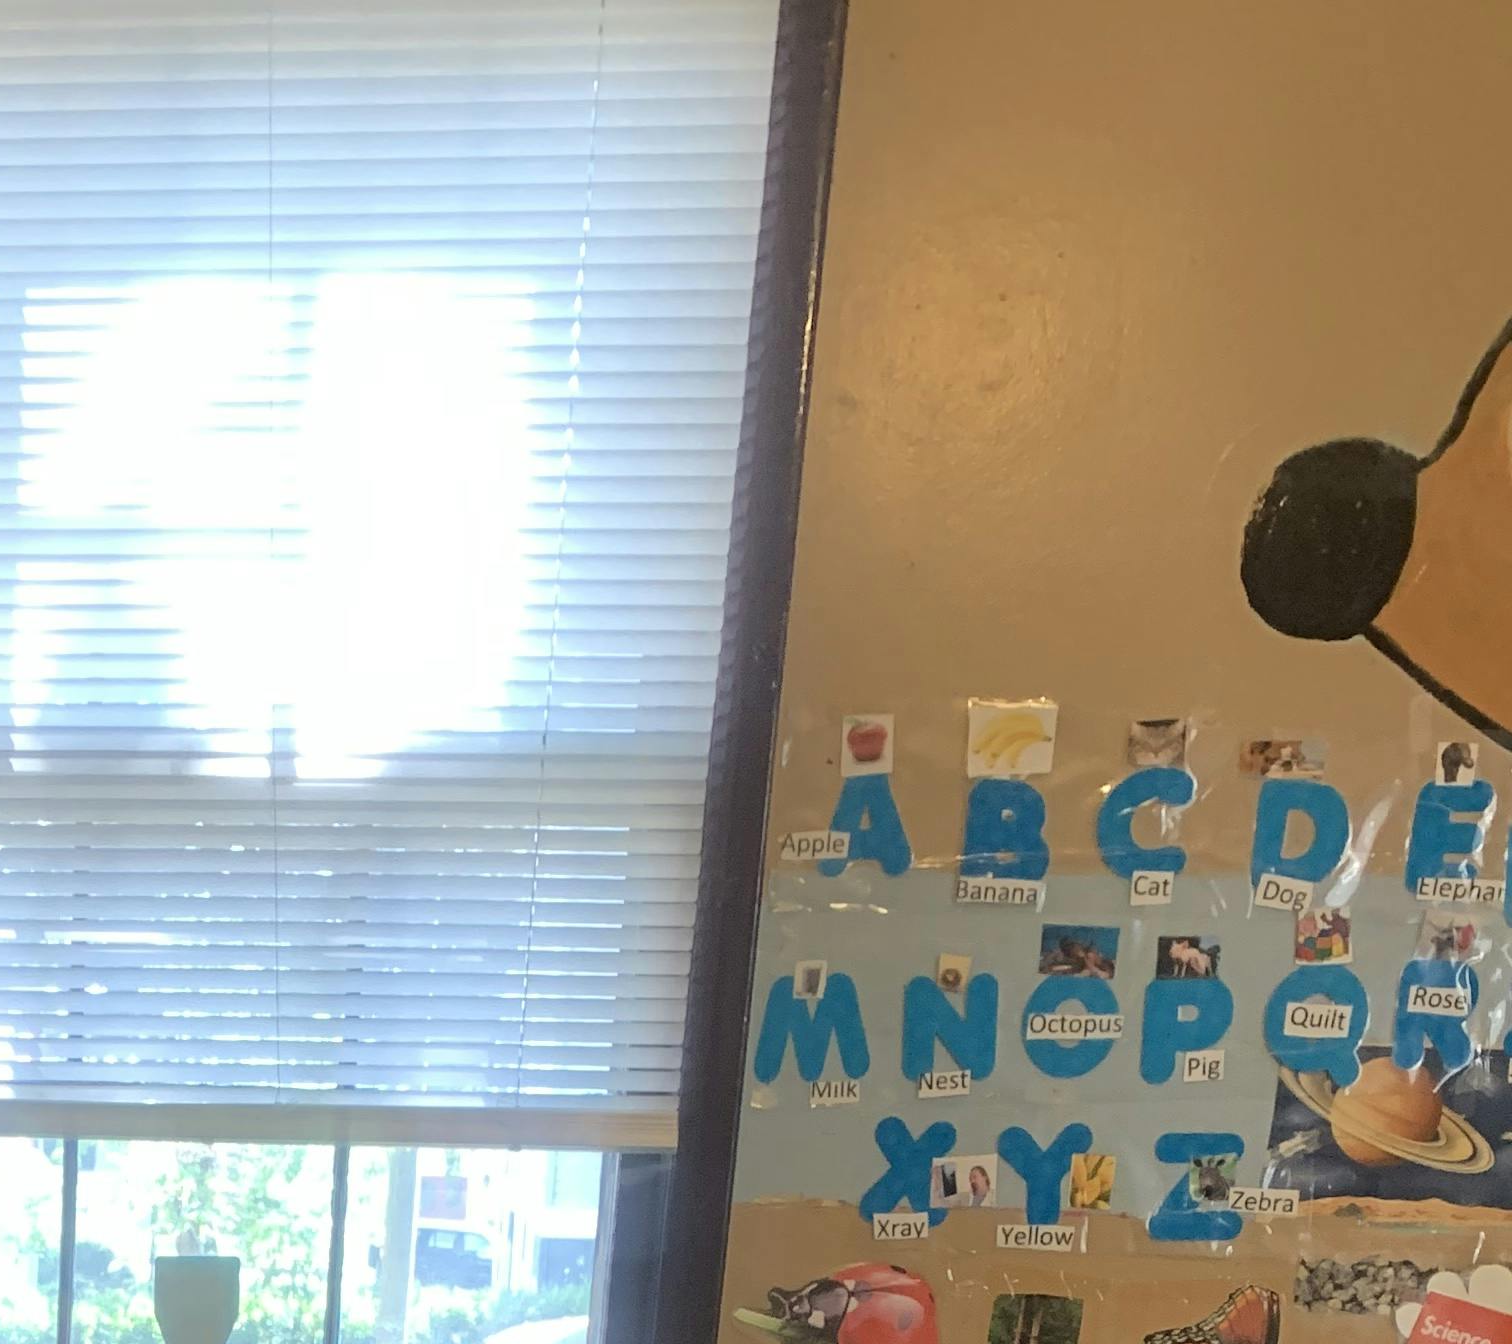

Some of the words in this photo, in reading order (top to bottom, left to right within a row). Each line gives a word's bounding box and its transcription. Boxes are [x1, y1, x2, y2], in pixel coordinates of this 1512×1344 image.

[817, 773, 913, 877] A
[959, 778, 1050, 880] B
[1096, 767, 1194, 880] C
[1251, 779, 1351, 886] D
[1405, 780, 1494, 891] E
[782, 832, 846, 856] Apple
[955, 880, 1038, 903] Banana
[1133, 875, 1170, 898] Cat
[1262, 880, 1309, 911] Dog
[1412, 986, 1468, 1010] Rose
[754, 973, 870, 1083] M
[902, 973, 998, 1081] N
[1023, 974, 1119, 1079] O
[1141, 978, 1233, 1085] P
[1264, 964, 1368, 1088] Q
[1393, 958, 1479, 1072] R
[1029, 1013, 1123, 1037] Octopus
[1290, 1007, 1347, 1032] Quilt
[1188, 1056, 1221, 1080] Pig
[810, 1081, 858, 1099] Milk
[919, 1071, 969, 1090] Nest
[859, 1116, 956, 1228] X
[997, 1123, 1093, 1224] Y
[1148, 1133, 1245, 1241] Z
[1230, 1191, 1295, 1214] Zebra
[877, 1218, 926, 1240] Xray
[1000, 1226, 1074, 1247] Yellow
